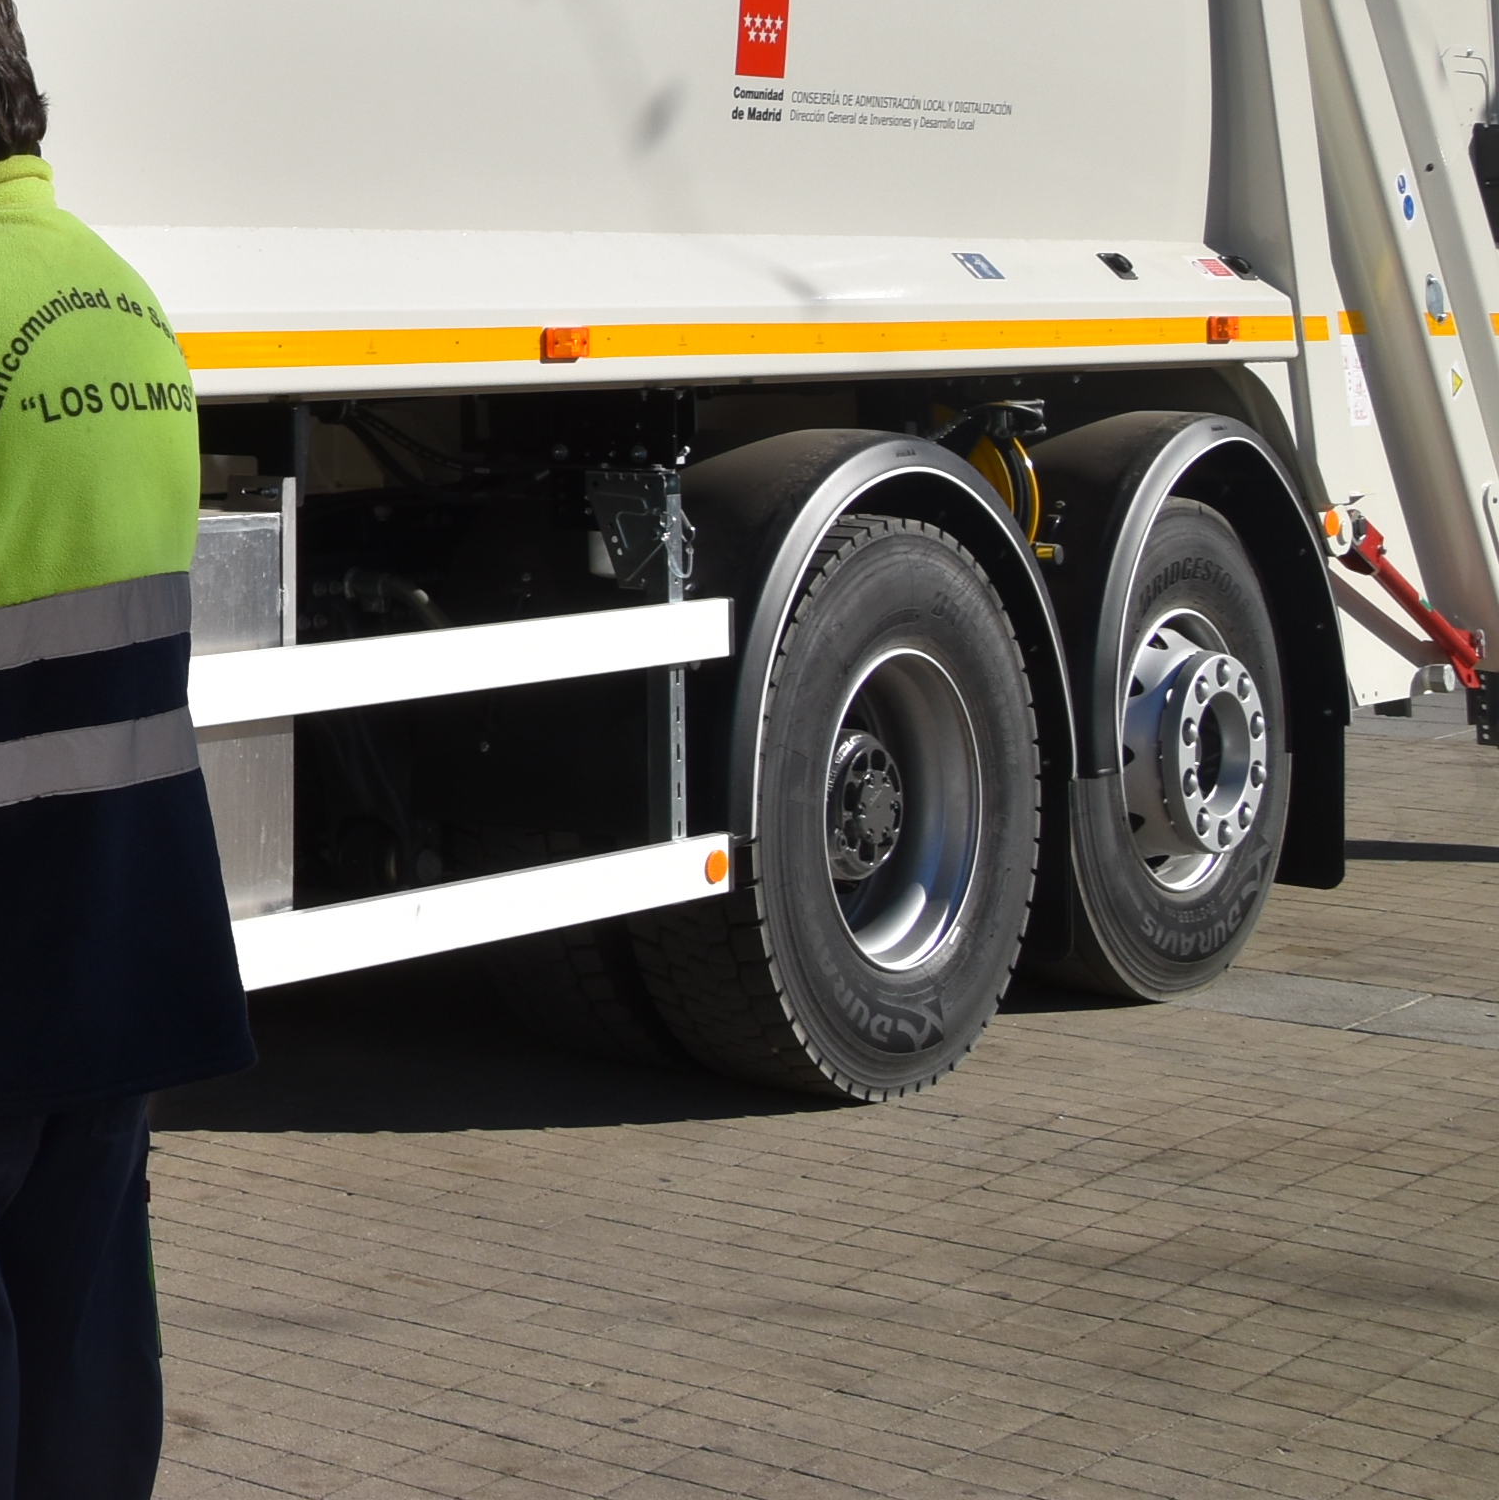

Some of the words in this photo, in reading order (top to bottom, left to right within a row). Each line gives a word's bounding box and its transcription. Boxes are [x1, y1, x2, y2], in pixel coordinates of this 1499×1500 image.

[733, 86, 784, 101] Comunidad
[791, 90, 840, 106] CONSEJERÍA
[843, 94, 853, 106] DE
[855, 94, 921, 110] ADMINISTRACIÓN
[923, 99, 946, 111] LOCAL
[947, 100, 953, 112] Y
[954, 100, 1012, 115] DIGITALIZACIÓN
[732, 107, 744, 120] de
[747, 107, 781, 121] Madrid
[790, 109, 825, 122] Dirección
[827, 111, 856, 124] General
[859, 112, 868, 125] de
[870, 114, 912, 127] Inversiones
[920, 116, 955, 130] Desarrollo
[957, 118, 975, 130] Local
[117, 293, 143, 317] de
[1140, 900, 1242, 956] DURAVIS
